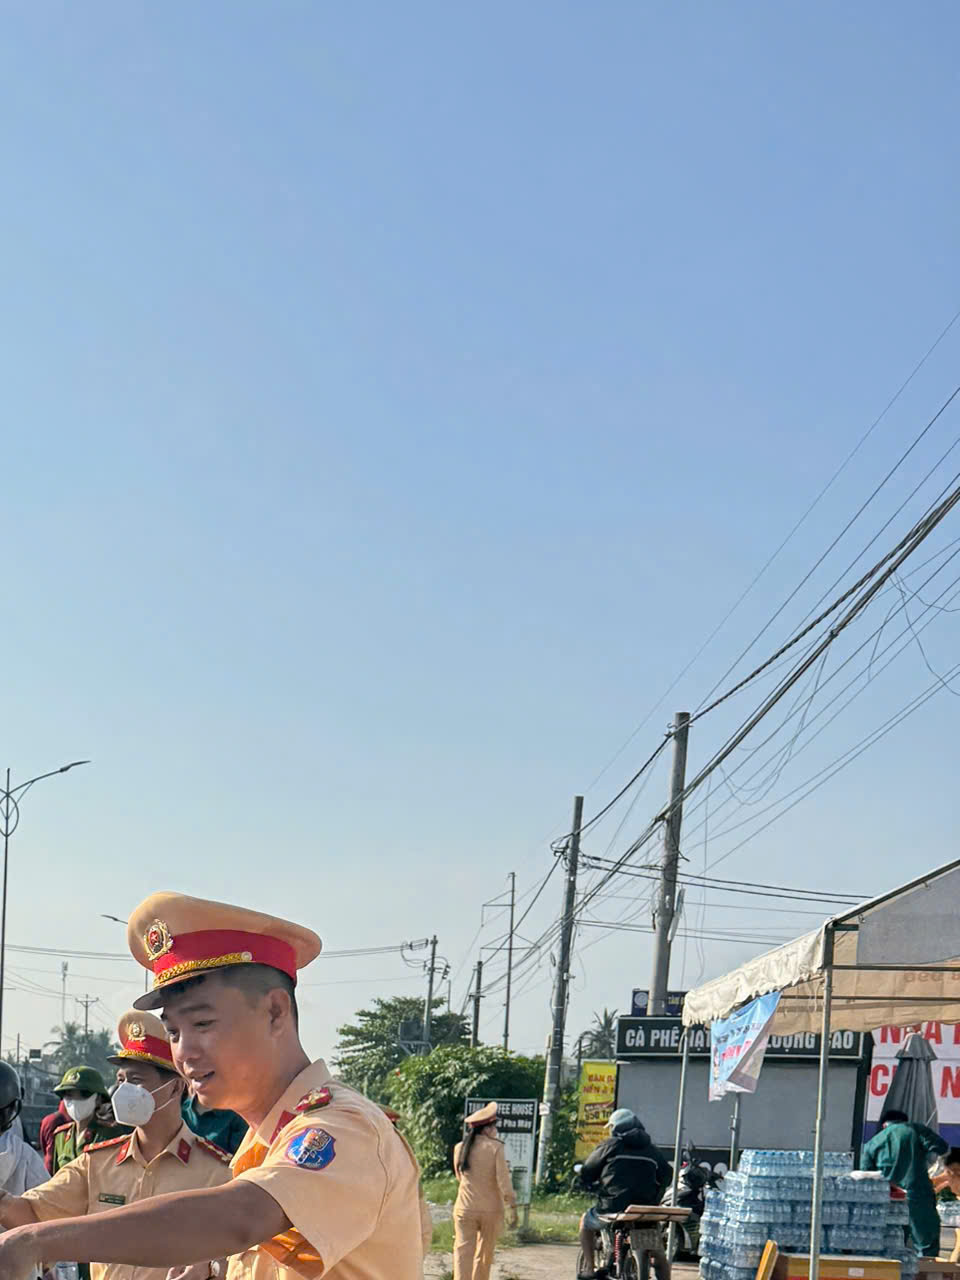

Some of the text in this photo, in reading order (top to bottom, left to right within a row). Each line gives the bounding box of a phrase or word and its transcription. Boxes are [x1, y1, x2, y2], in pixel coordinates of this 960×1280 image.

[625, 1025, 645, 1047] CÀ
[650, 1025, 680, 1047] PHÊ
[828, 1031, 854, 1049] AO
[512, 1103, 533, 1115] HOUSE
